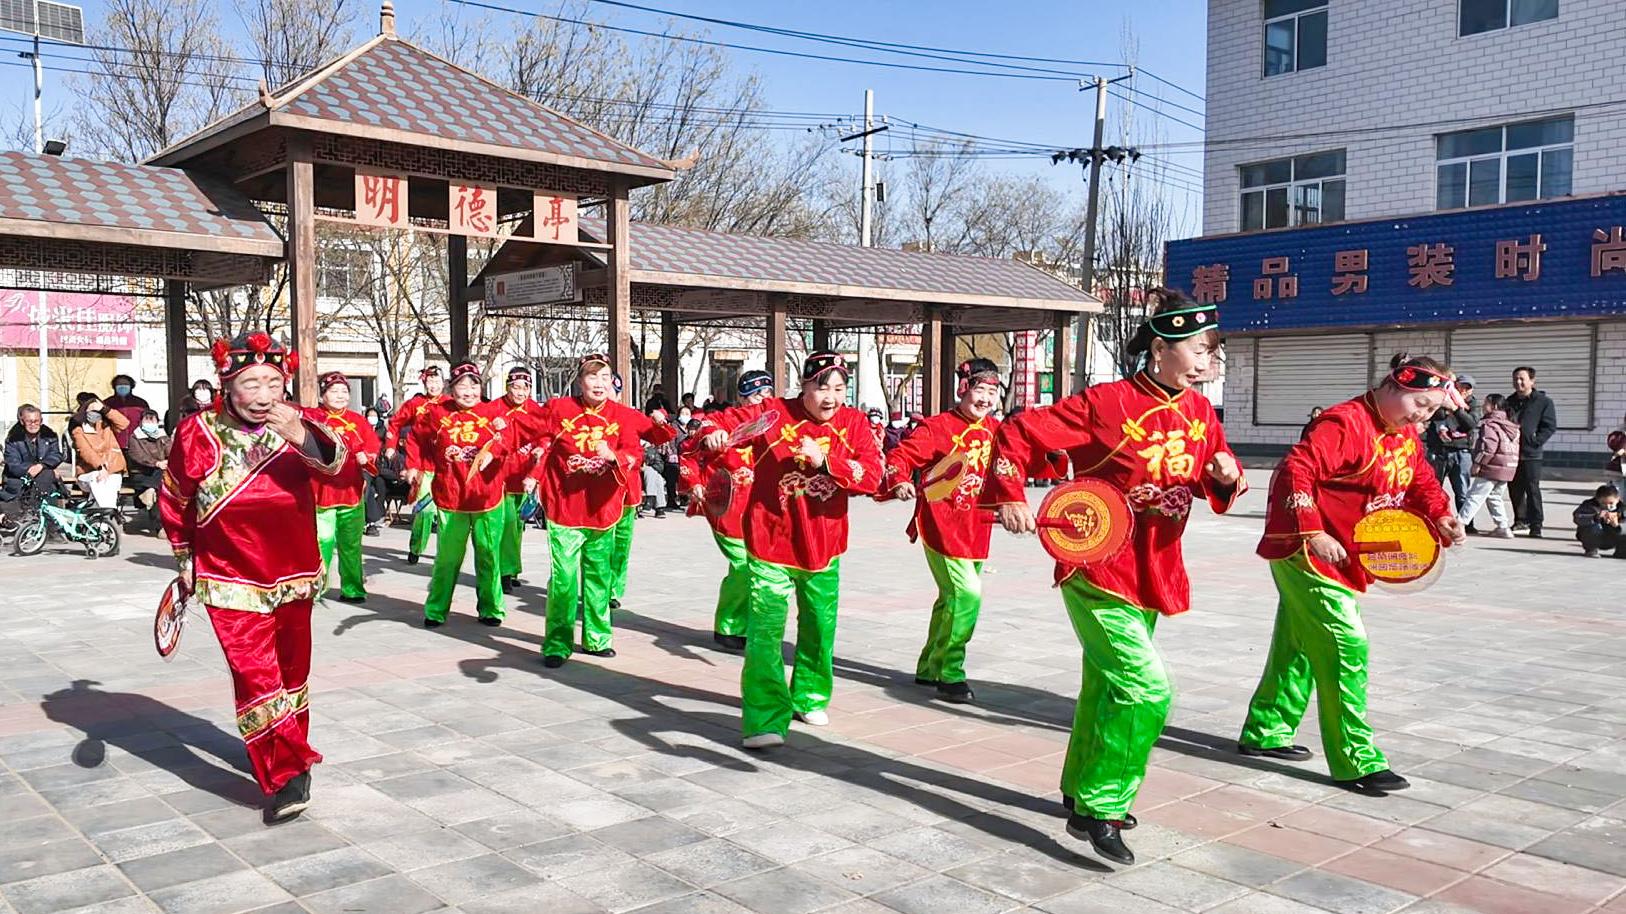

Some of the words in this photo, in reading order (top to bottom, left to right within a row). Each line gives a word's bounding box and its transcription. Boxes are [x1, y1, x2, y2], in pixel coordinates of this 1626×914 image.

[363, 175, 569, 240] 明德亭
[1191, 226, 1626, 302] 精品男装时尚
[448, 421, 479, 443] 福
[1137, 429, 1195, 480] 福
[1382, 447, 1413, 489] 福
